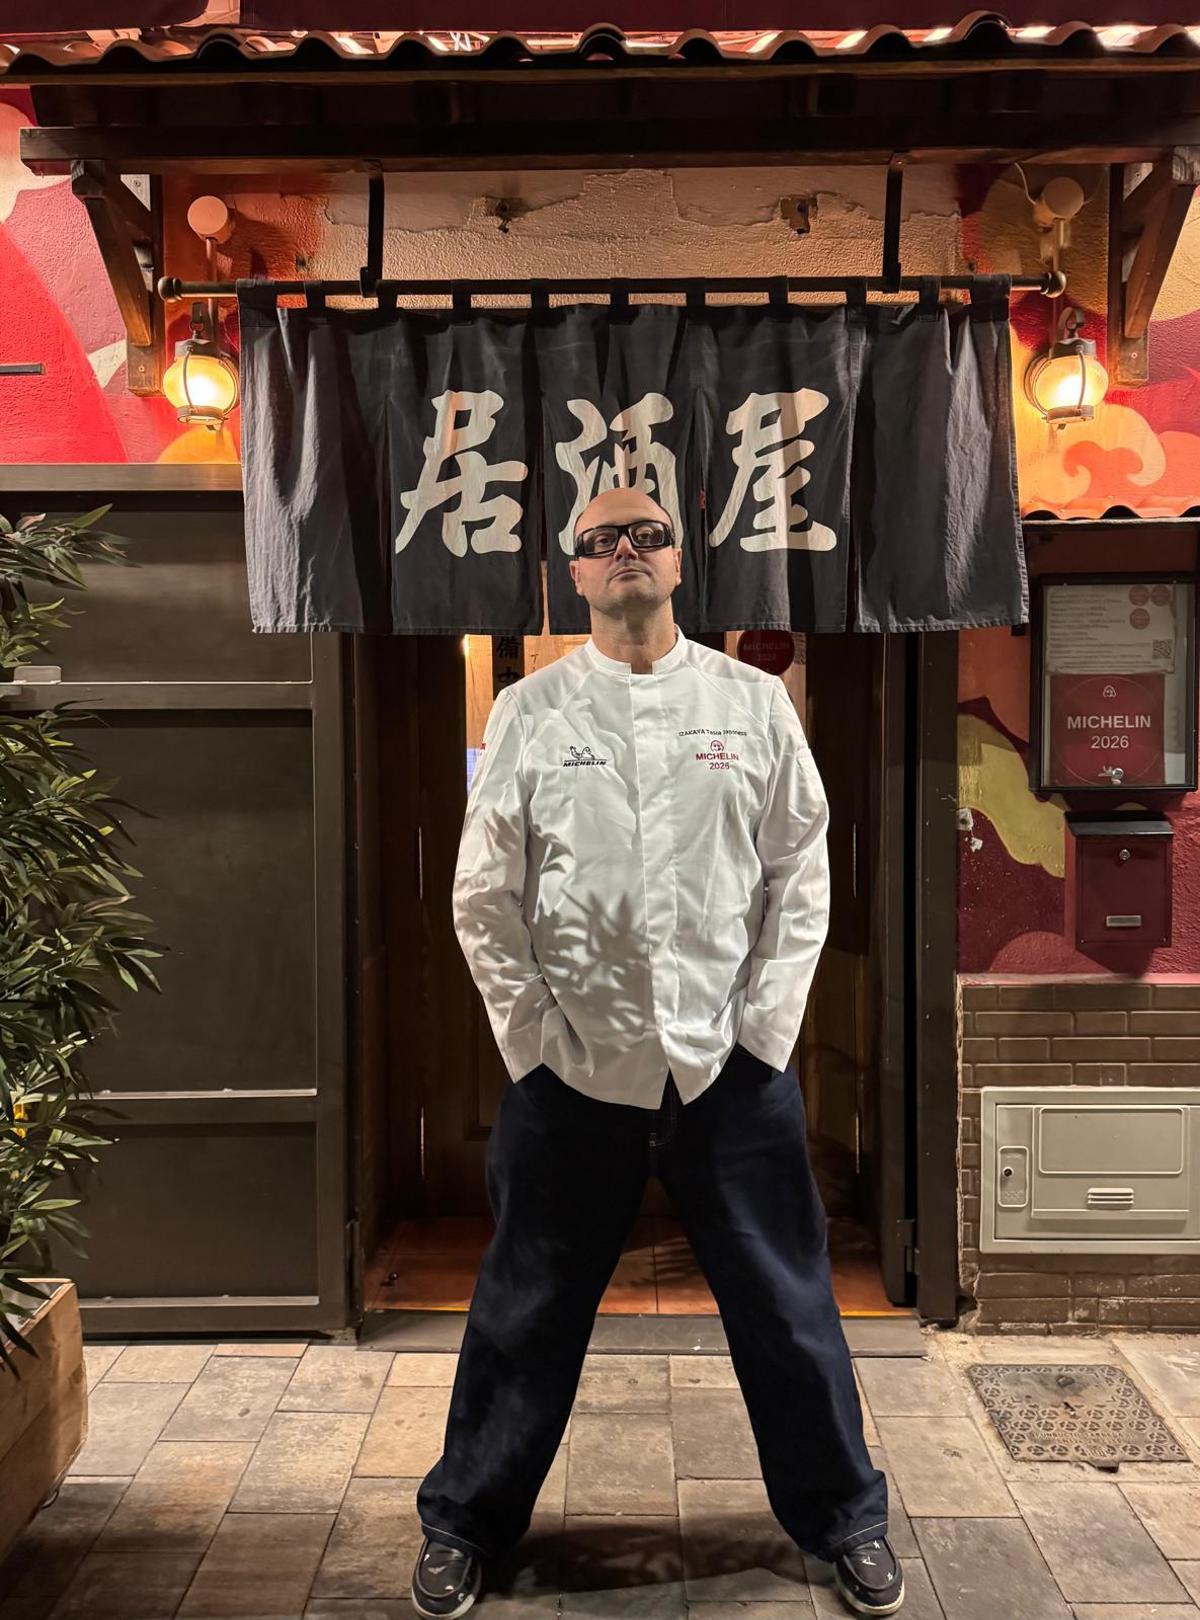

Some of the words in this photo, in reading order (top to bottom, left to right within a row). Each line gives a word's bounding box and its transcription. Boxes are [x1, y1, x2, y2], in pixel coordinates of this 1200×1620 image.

[395, 388, 837, 557] 居酒屋
[1067, 715, 1151, 729] MICHELIN
[678, 728, 706, 737] IZAKAYA
[1091, 735, 1129, 749] 2026
[696, 752, 739, 761] MICHELIN
[563, 760, 607, 768] MICHELIN
[709, 762, 730, 770] 2026
